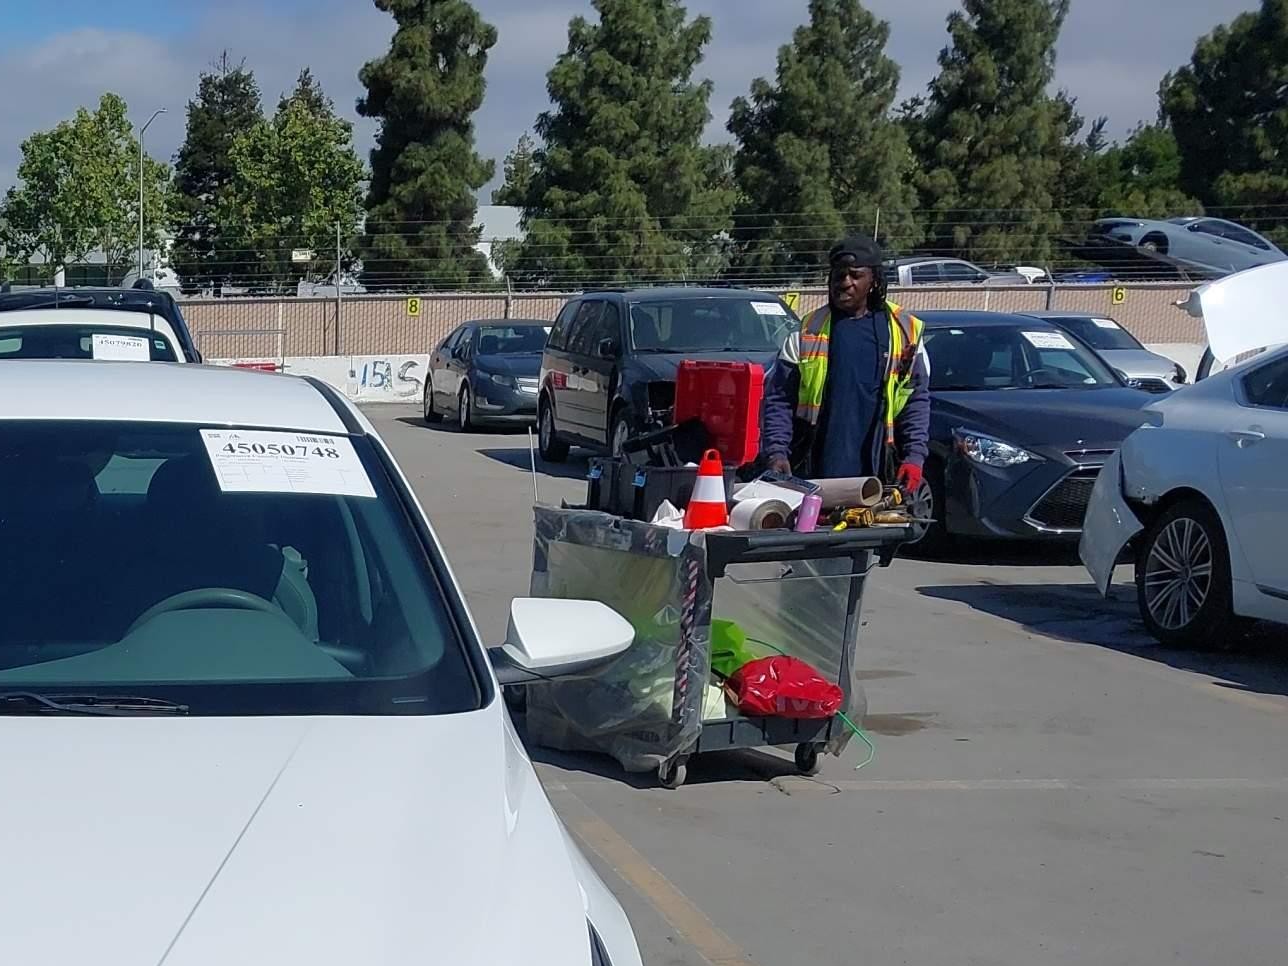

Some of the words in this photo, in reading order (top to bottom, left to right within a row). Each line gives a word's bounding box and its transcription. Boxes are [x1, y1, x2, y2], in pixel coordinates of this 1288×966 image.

[1115, 287, 1124, 301] 6
[408, 299, 418, 313] 8
[787, 294, 797, 310] 7
[222, 442, 340, 459] 45050748
